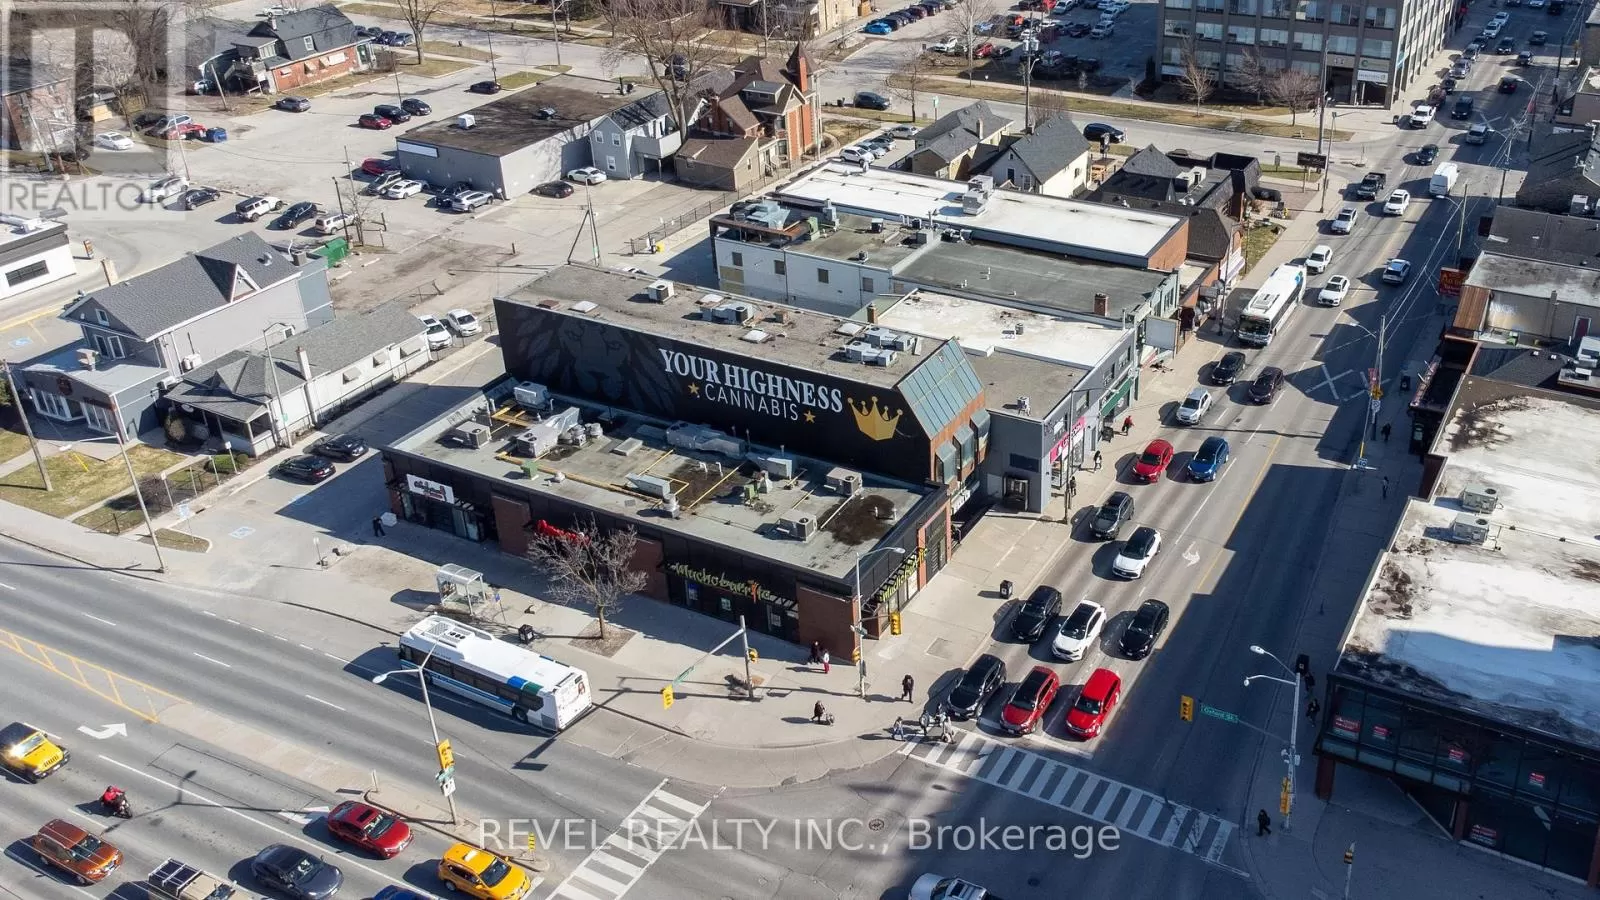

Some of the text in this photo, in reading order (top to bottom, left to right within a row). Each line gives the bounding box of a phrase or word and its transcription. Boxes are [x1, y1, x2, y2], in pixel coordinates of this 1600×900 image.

[658, 348, 843, 414] YOUR HIGHNESS
[704, 384, 799, 421] CANNABIS
